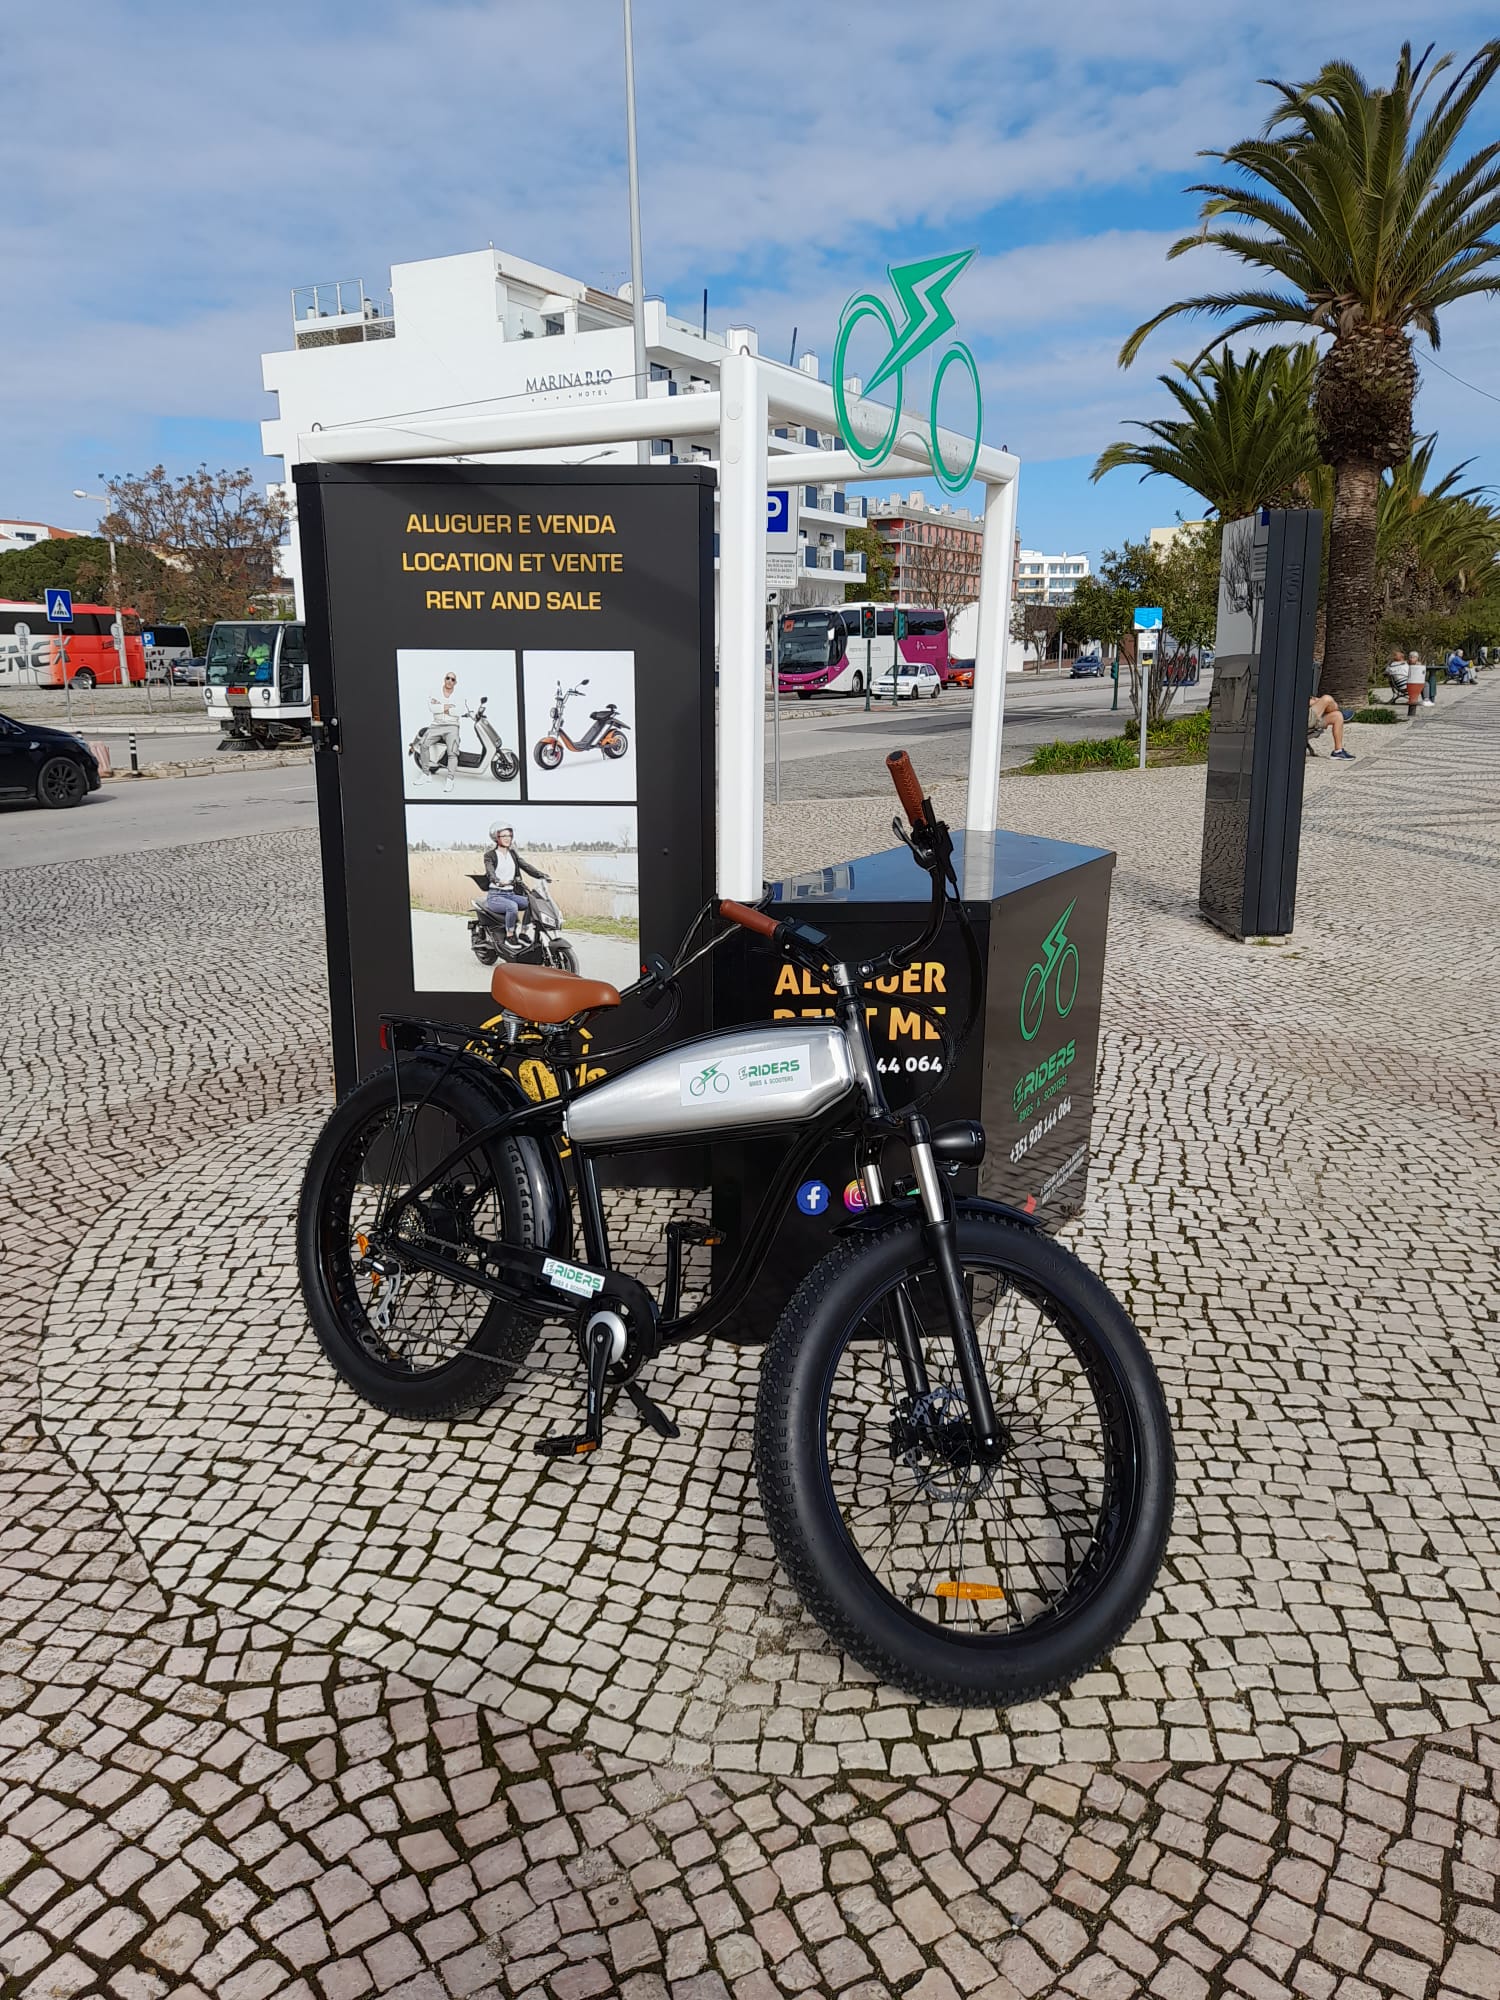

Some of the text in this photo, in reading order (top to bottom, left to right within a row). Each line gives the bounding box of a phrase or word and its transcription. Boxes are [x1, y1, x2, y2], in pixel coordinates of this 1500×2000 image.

[578, 389, 608, 398] HOTEL
[406, 513, 616, 535] ALUGUER E VENDA
[402, 552, 624, 573] LOCATION ET VENTE
[426, 590, 602, 611] RENT AND SALE
[905, 1055, 943, 1073] 064
[1018, 1102, 1034, 1123] BIKES
[1043, 1073, 1068, 1102] SCOOTERS
[1009, 1134, 1028, 1164] +351
[1029, 1119, 1043, 1149] 928
[1058, 1095, 1072, 1120] 064
